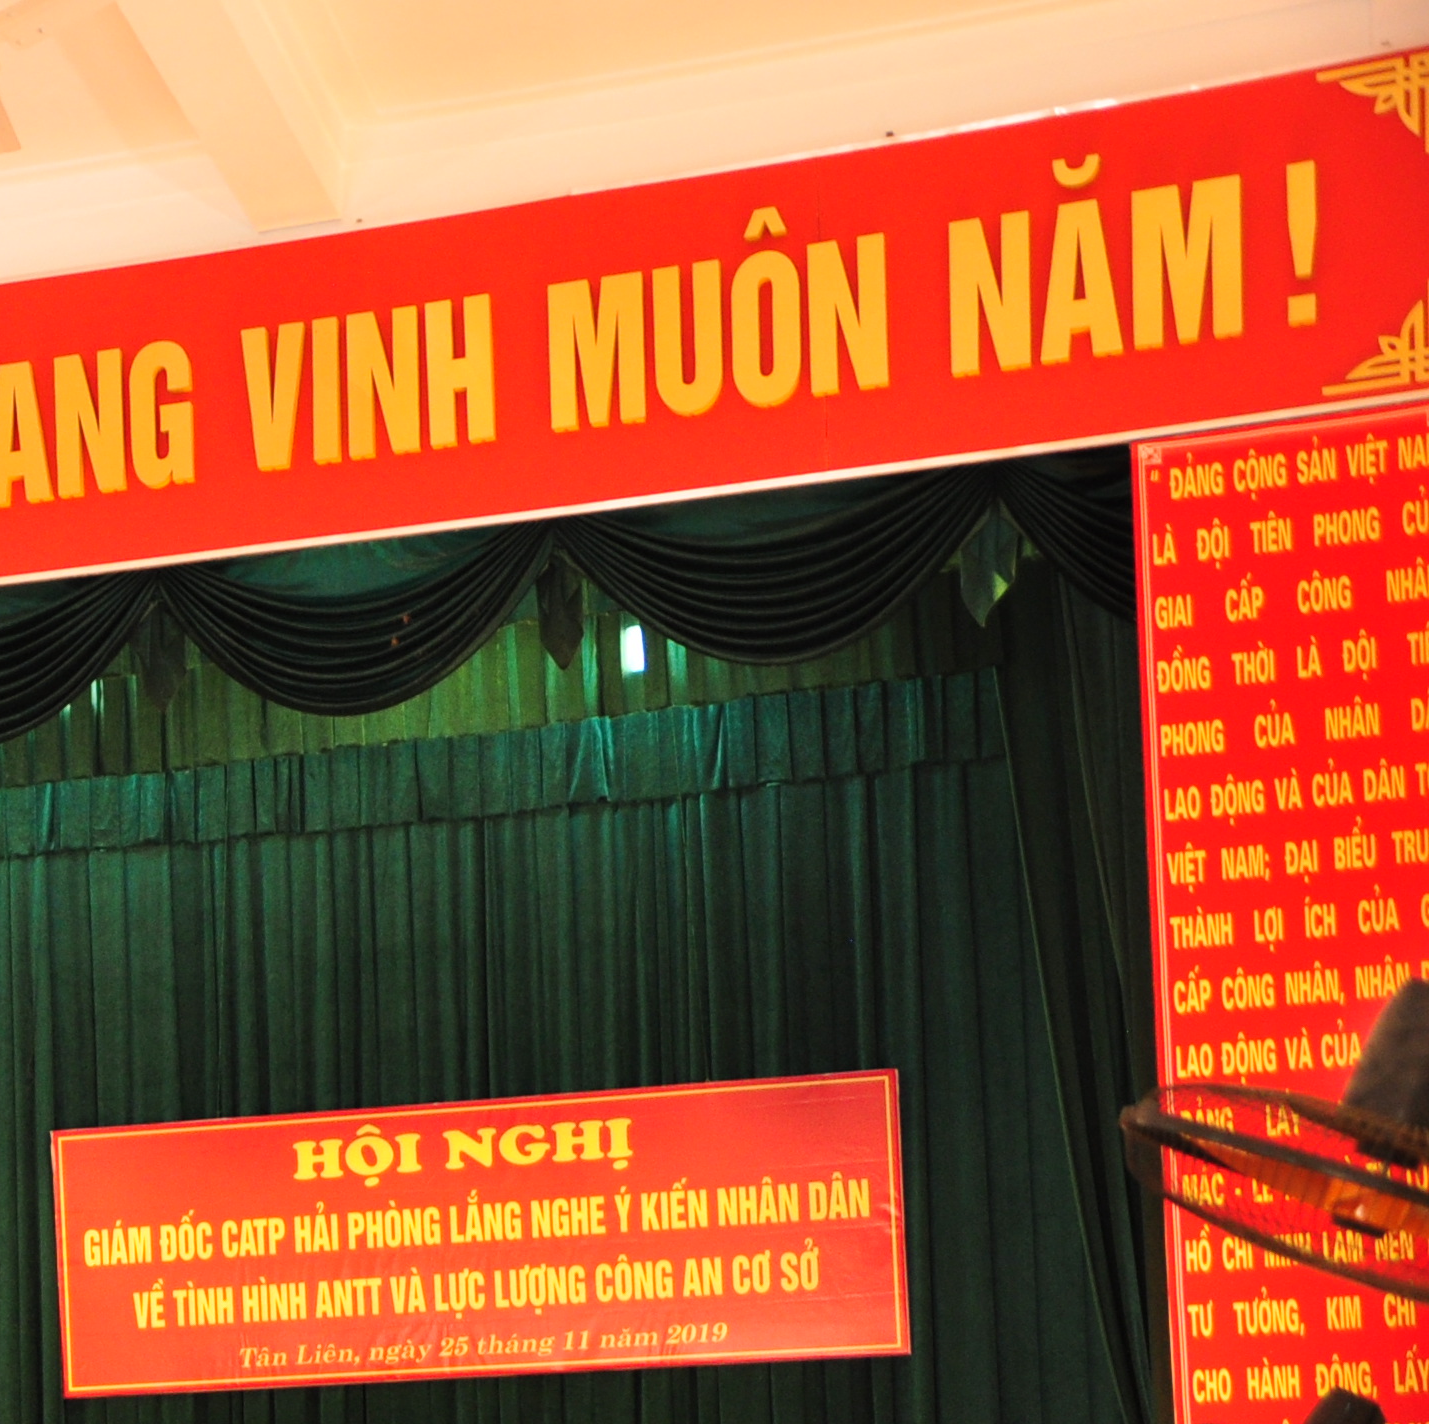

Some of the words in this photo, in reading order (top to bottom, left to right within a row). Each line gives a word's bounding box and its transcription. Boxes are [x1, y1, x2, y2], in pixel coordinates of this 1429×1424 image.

[241, 294, 496, 471] VINH
[548, 207, 889, 432] MUÔN
[949, 154, 1243, 378] NĂM
[1287, 160, 1317, 326] !
[1170, 453, 1224, 499] ĐẢNG
[1233, 449, 1287, 500] CỘNG
[1297, 436, 1337, 484] SẢN
[1346, 433, 1388, 483] VIỆT
[1153, 524, 1176, 565] LÀ
[1197, 518, 1229, 569] ĐỘI
[1250, 511, 1292, 553] TIÊN
[1314, 507, 1380, 546] PHONG
[1155, 595, 1192, 629] GIAI
[1226, 573, 1264, 622] CẤP
[1297, 571, 1352, 614] CÔNG
[1157, 645, 1211, 693] ĐỒNG
[1232, 642, 1275, 684] THỜI
[1297, 636, 1322, 678] LÀ
[1343, 629, 1377, 680] ĐỘI
[1161, 719, 1224, 756] PHONG
[1254, 700, 1295, 748] CỦA
[1325, 696, 1380, 740] NHÂN
[1164, 786, 1201, 821] LAO
[1210, 774, 1265, 825] ĐỘNG
[1275, 768, 1302, 810] VÀ
[1312, 759, 1353, 807] CỦA
[1363, 759, 1405, 802] DÂN
[1167, 842, 1206, 892] VIỆT
[1285, 840, 1318, 883] ĐẠI
[1334, 816, 1376, 870] BIỂU
[1170, 906, 1233, 949] THÀNH
[1254, 907, 1283, 951] LỢI
[1305, 897, 1336, 938] ÍCH
[1358, 885, 1399, 934] CỦA
[1174, 966, 1211, 1014] CẤP
[1222, 968, 1275, 1010] CÔNG
[1176, 1044, 1213, 1078] LAO
[1221, 1032, 1277, 1084] ĐỘNG
[1285, 1028, 1313, 1070] VÀ
[293, 1125, 422, 1187] HỘI
[443, 1118, 633, 1170] NGHỊ
[84, 1220, 152, 1267] GIÁM
[160, 1210, 213, 1262] ĐỐC
[222, 1218, 285, 1258] CATP
[294, 1202, 339, 1253] HẢI
[348, 1201, 441, 1250] PHÒNG
[450, 1190, 522, 1243] LẮNG
[531, 1196, 606, 1238] NGHE
[615, 1186, 631, 1232] Ý
[641, 1178, 708, 1231] KIẾN
[717, 1177, 799, 1226] NHÂN
[809, 1172, 869, 1220] DÂN
[1185, 1224, 1211, 1272] HỒ
[133, 1279, 165, 1328] VỀ
[173, 1281, 234, 1326] TÌNH
[242, 1277, 306, 1322] HÌNH
[316, 1278, 382, 1318] ANTT
[390, 1267, 426, 1314] VÀ
[434, 1268, 485, 1319] LỰC
[494, 1264, 586, 1314] LƯỢNG
[596, 1254, 673, 1302] CÔNG
[683, 1257, 723, 1297] AN
[732, 1250, 770, 1294] CƠ
[781, 1238, 819, 1292] SỞ
[240, 1347, 286, 1368] Tân
[297, 1344, 360, 1365] Liên,
[369, 1340, 432, 1364] ngày
[440, 1336, 468, 1357] 25
[478, 1334, 555, 1356] tháng
[563, 1330, 588, 1350] 11
[601, 1329, 657, 1348] năm
[666, 1323, 727, 1344] 2019
[1187, 1301, 1213, 1337] TƯ
[1326, 1296, 1361, 1330] KIM
[1193, 1368, 1231, 1403] CHO
[1247, 1358, 1300, 1400] HÀNH
